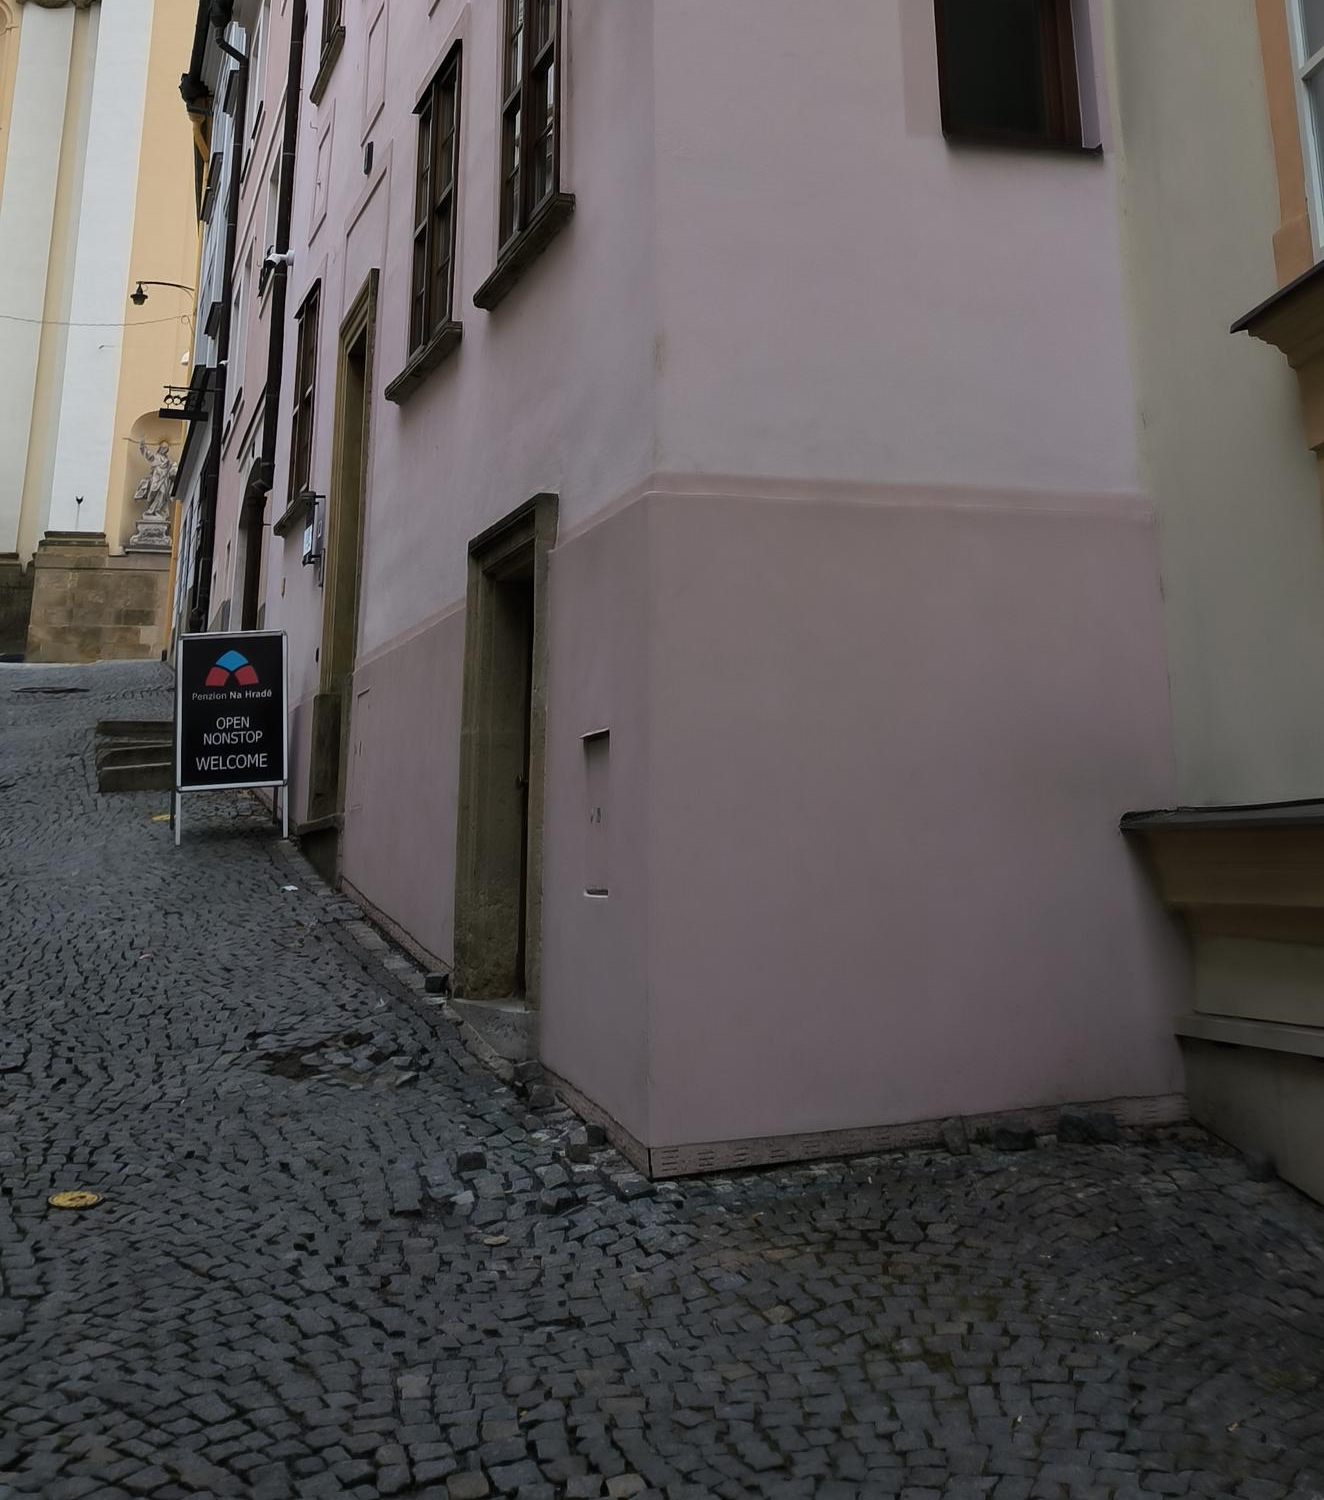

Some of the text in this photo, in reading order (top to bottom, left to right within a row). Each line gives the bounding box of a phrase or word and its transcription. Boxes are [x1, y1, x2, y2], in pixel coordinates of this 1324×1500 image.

[192, 692, 227, 700] Penzion
[229, 691, 242, 699] Na
[216, 716, 250, 730] OPEN
[203, 730, 263, 746] NONSTOP
[196, 753, 268, 771] WELCOME
